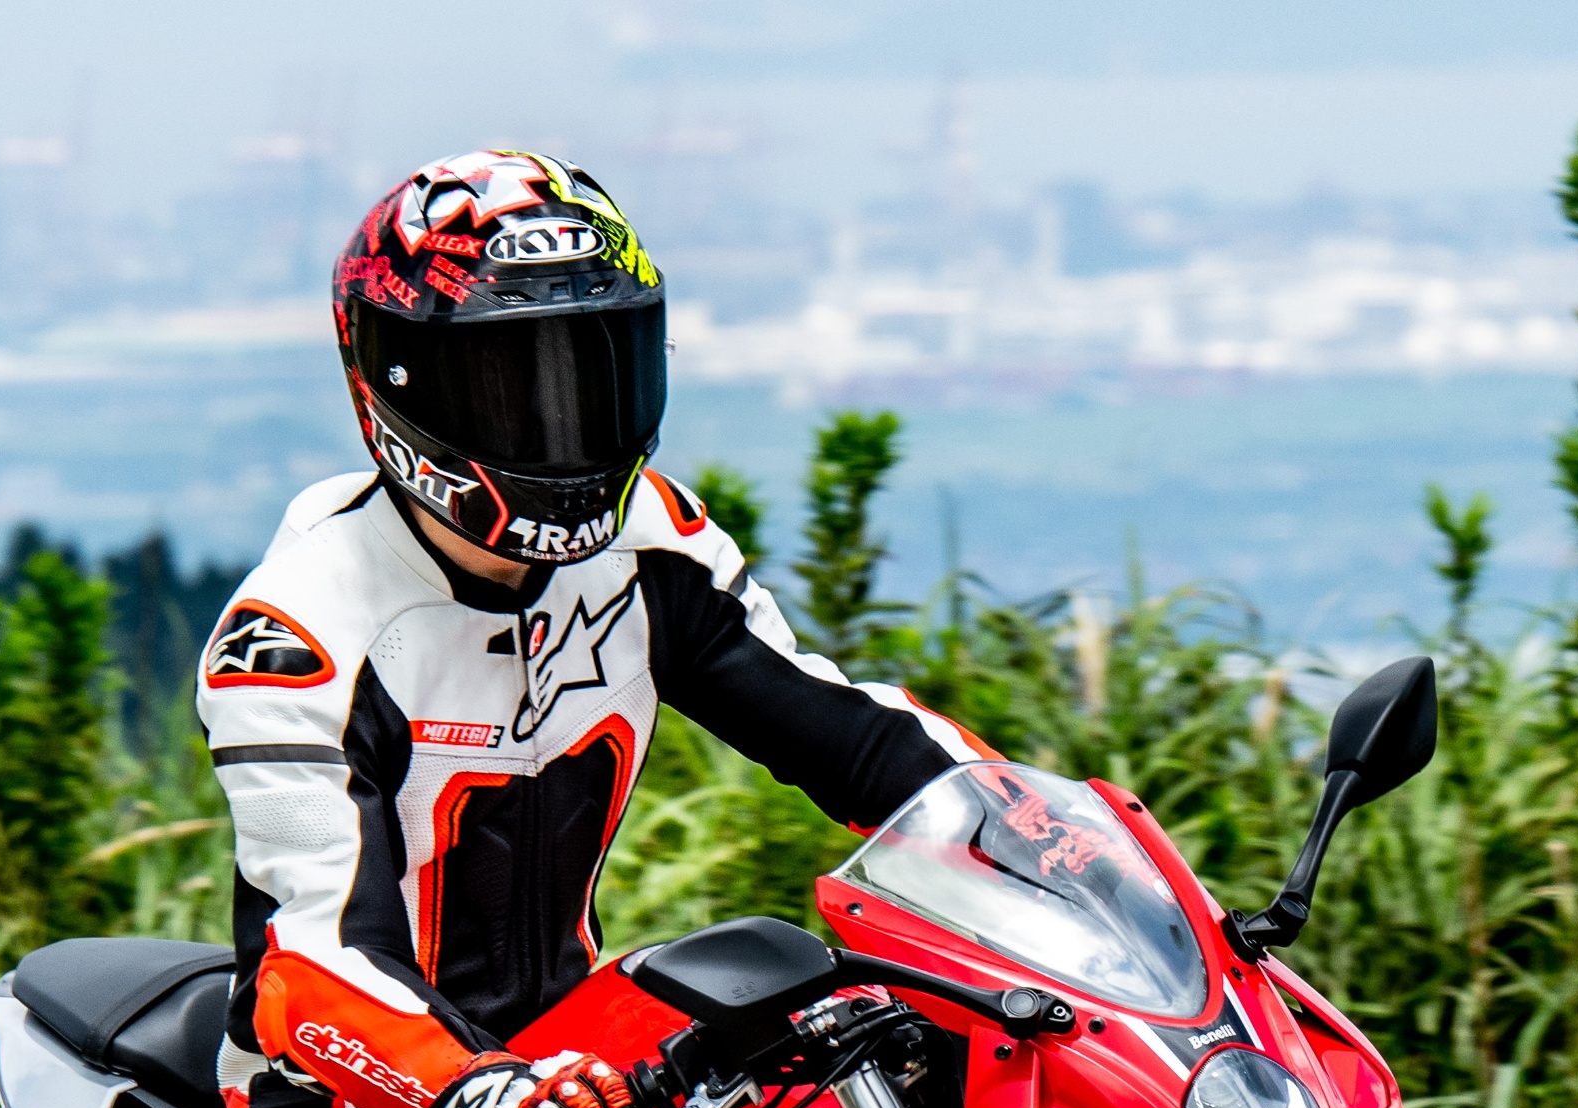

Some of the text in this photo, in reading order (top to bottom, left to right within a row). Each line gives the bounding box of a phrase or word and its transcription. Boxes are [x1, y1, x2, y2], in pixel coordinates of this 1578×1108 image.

[501, 226, 590, 259] KYT
[364, 400, 481, 507] KYT
[1187, 1023, 1237, 1050] Benelli
